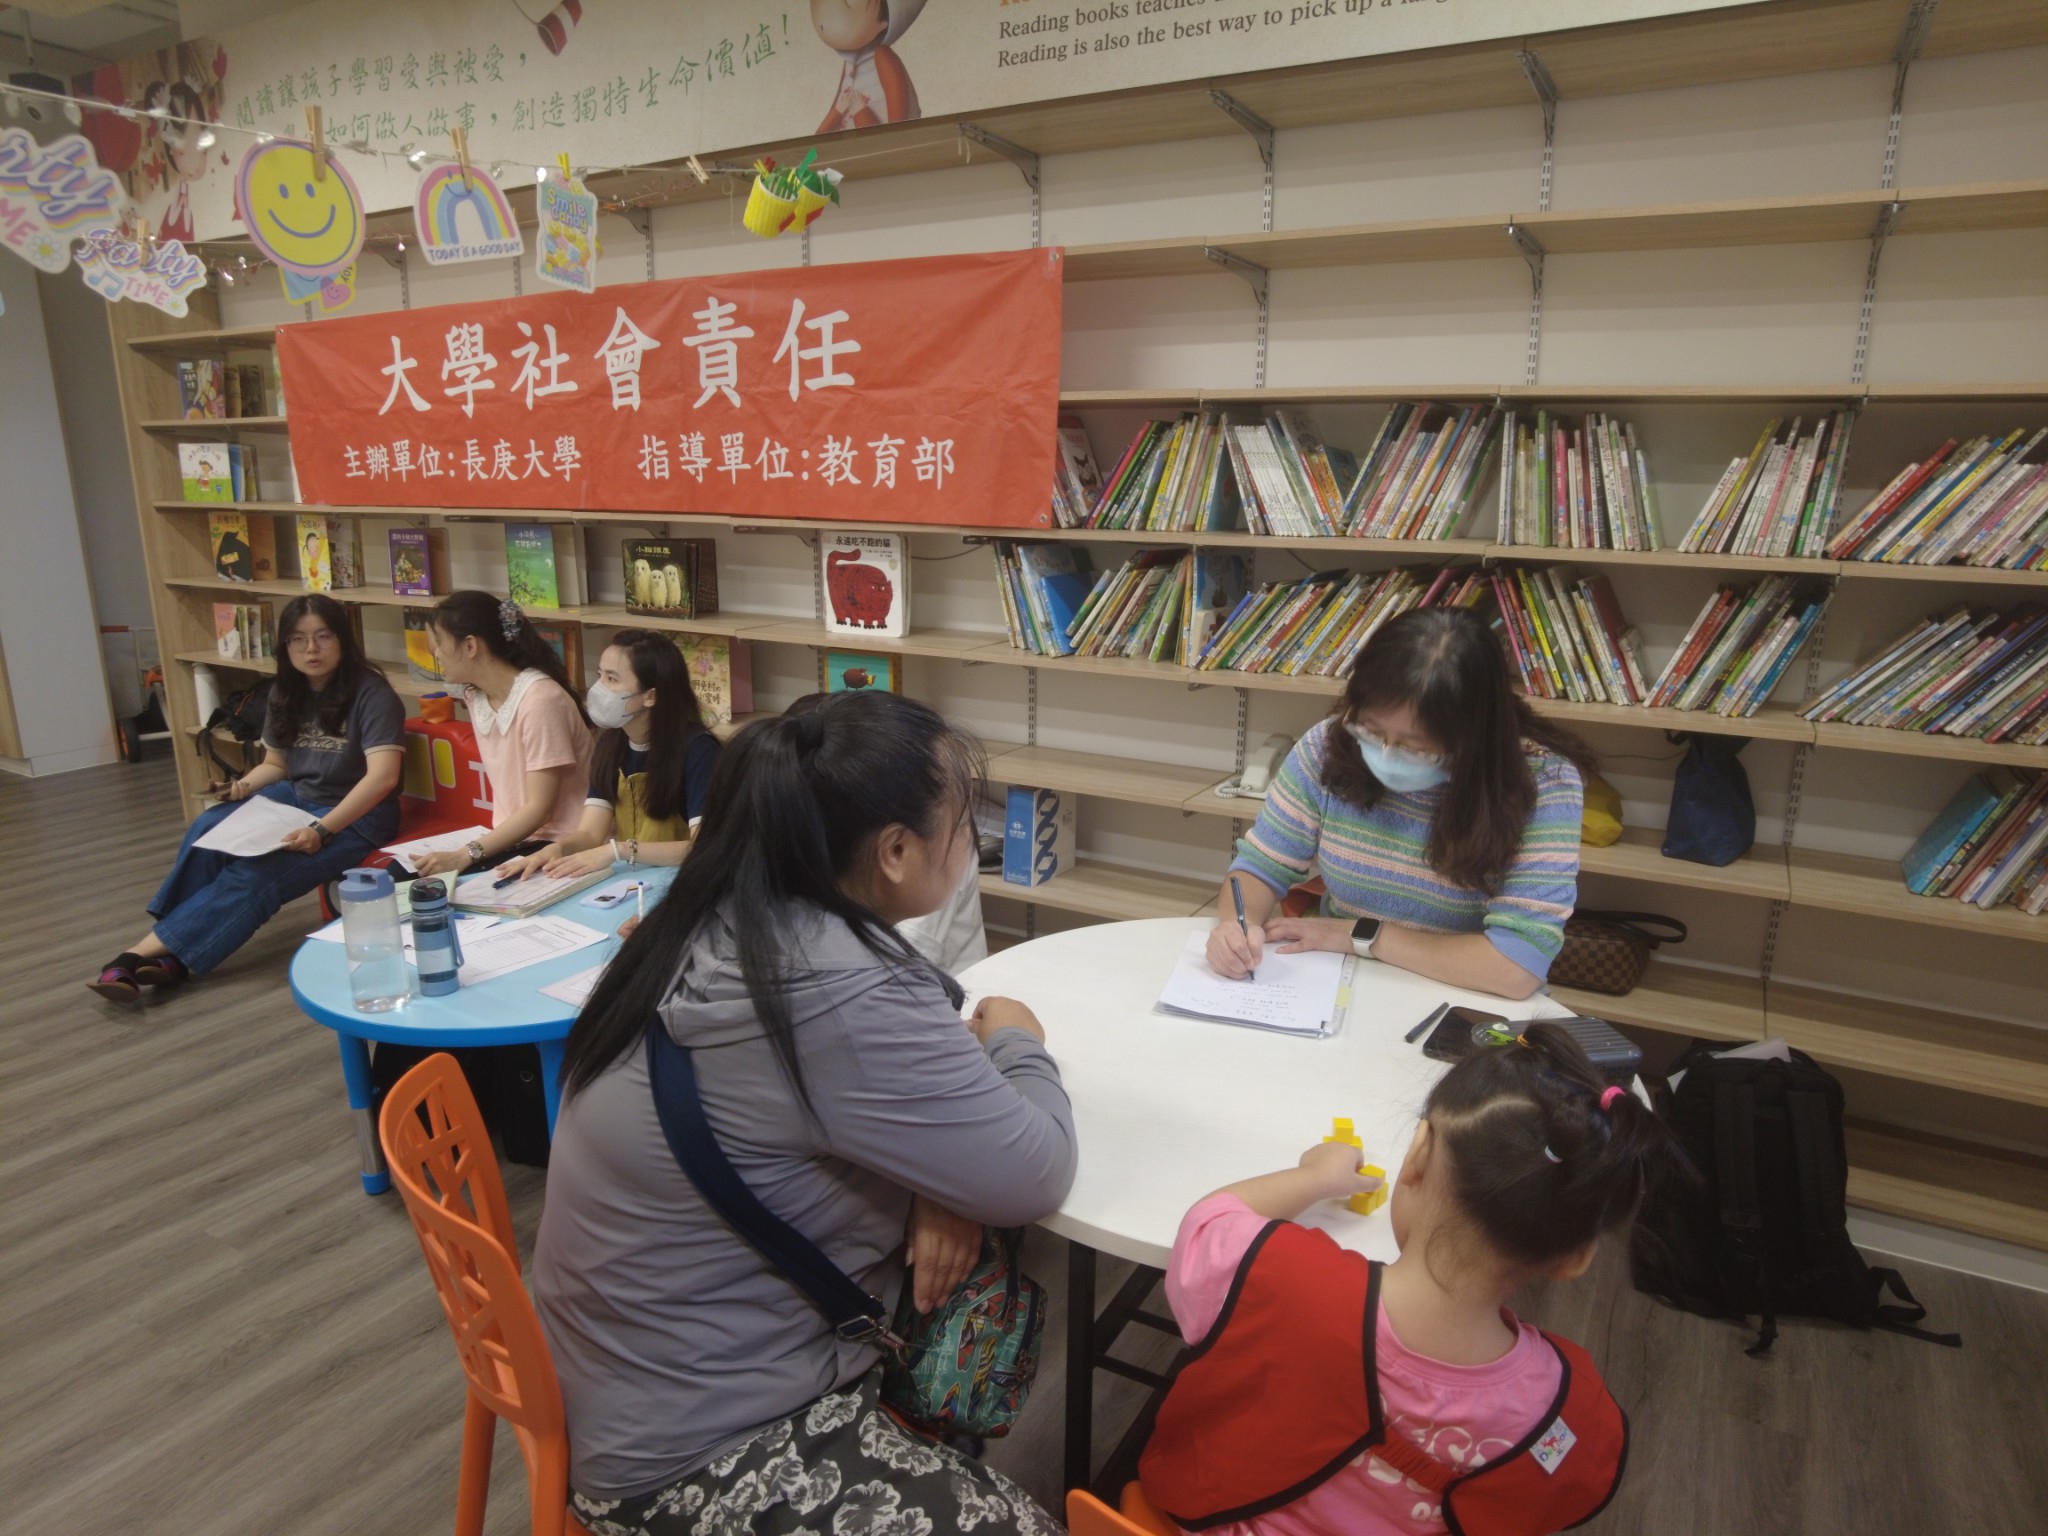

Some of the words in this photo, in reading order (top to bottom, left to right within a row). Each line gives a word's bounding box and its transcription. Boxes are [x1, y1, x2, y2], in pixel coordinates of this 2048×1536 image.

[998, 44, 1068, 68] Reading
[1073, 39, 1088, 55] is
[1094, 33, 1130, 52] also
[1137, 26, 1166, 45] the
[1173, 19, 1211, 40] best
[1218, 13, 1257, 33] way
[1264, 10, 1283, 26] to
[1290, 0, 1337, 26] pick
[1345, 0, 1373, 15] up
[1000, 13, 1070, 39] Reading
[1076, 3, 1129, 26] books
[546, 187, 587, 217] Smile
[551, 204, 589, 235] Candy
[428, 247, 461, 262] TODAY
[472, 246, 479, 257] A
[479, 243, 503, 256] GOOD
[503, 241, 521, 254] DAY
[126, 276, 169, 306] TIME
[378, 296, 862, 419] 大學社會責任
[343, 435, 582, 483] 主辦單位：長庚大學
[637, 431, 955, 491] 指導單位：教育部
